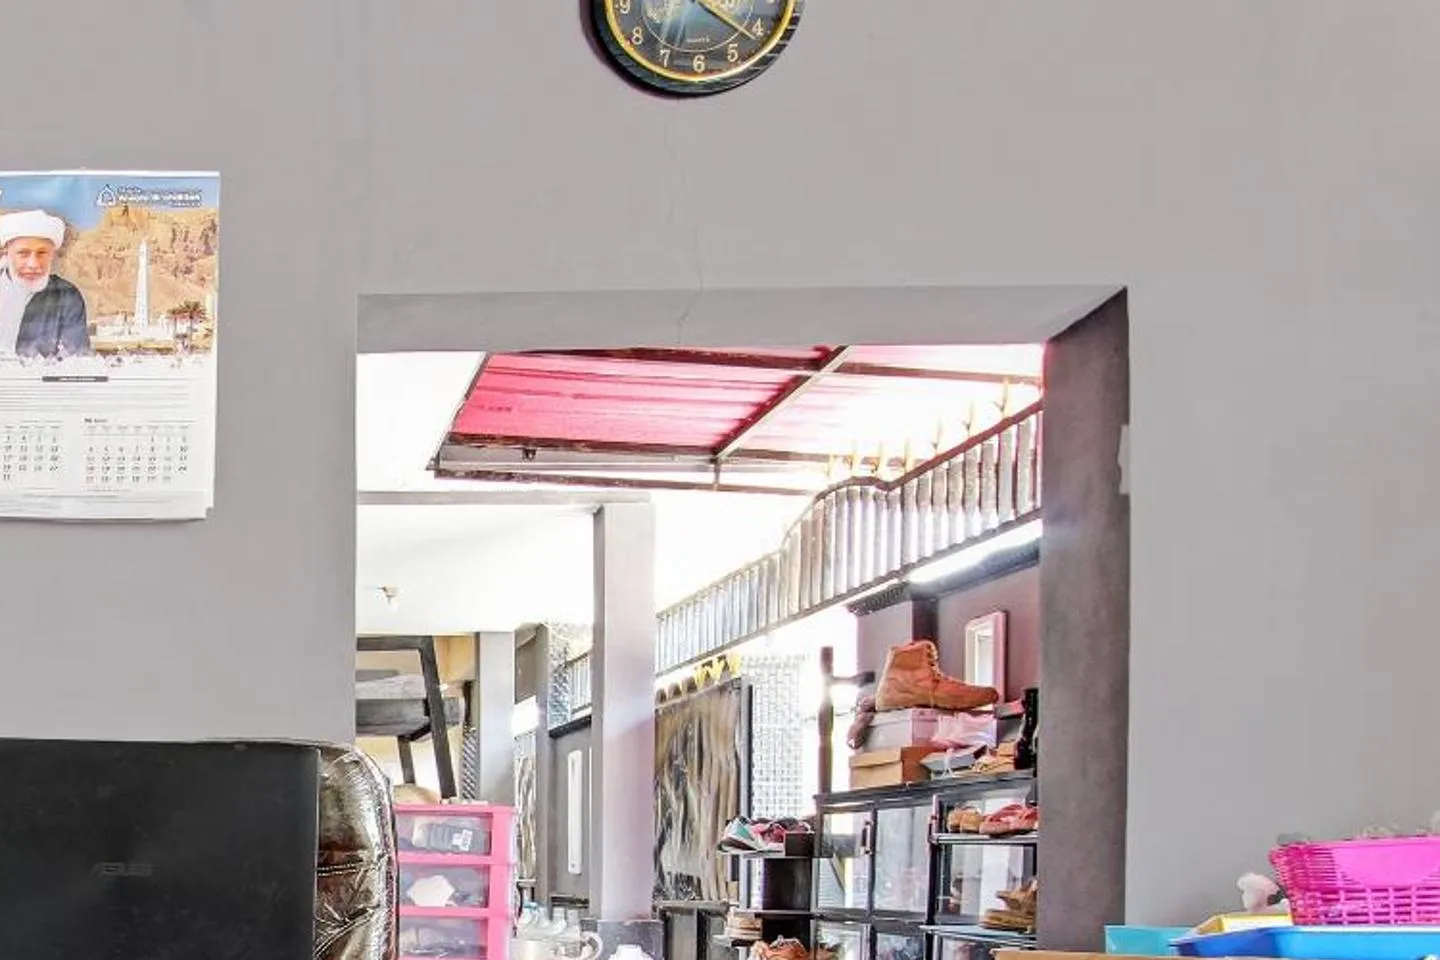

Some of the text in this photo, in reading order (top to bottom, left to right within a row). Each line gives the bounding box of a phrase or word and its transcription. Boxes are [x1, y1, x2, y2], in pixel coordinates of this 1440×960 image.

[631, 26, 644, 45] 8
[752, 17, 764, 36] 4
[660, 49, 671, 68] 7
[727, 43, 738, 62] 5
[692, 54, 706, 73] 6
